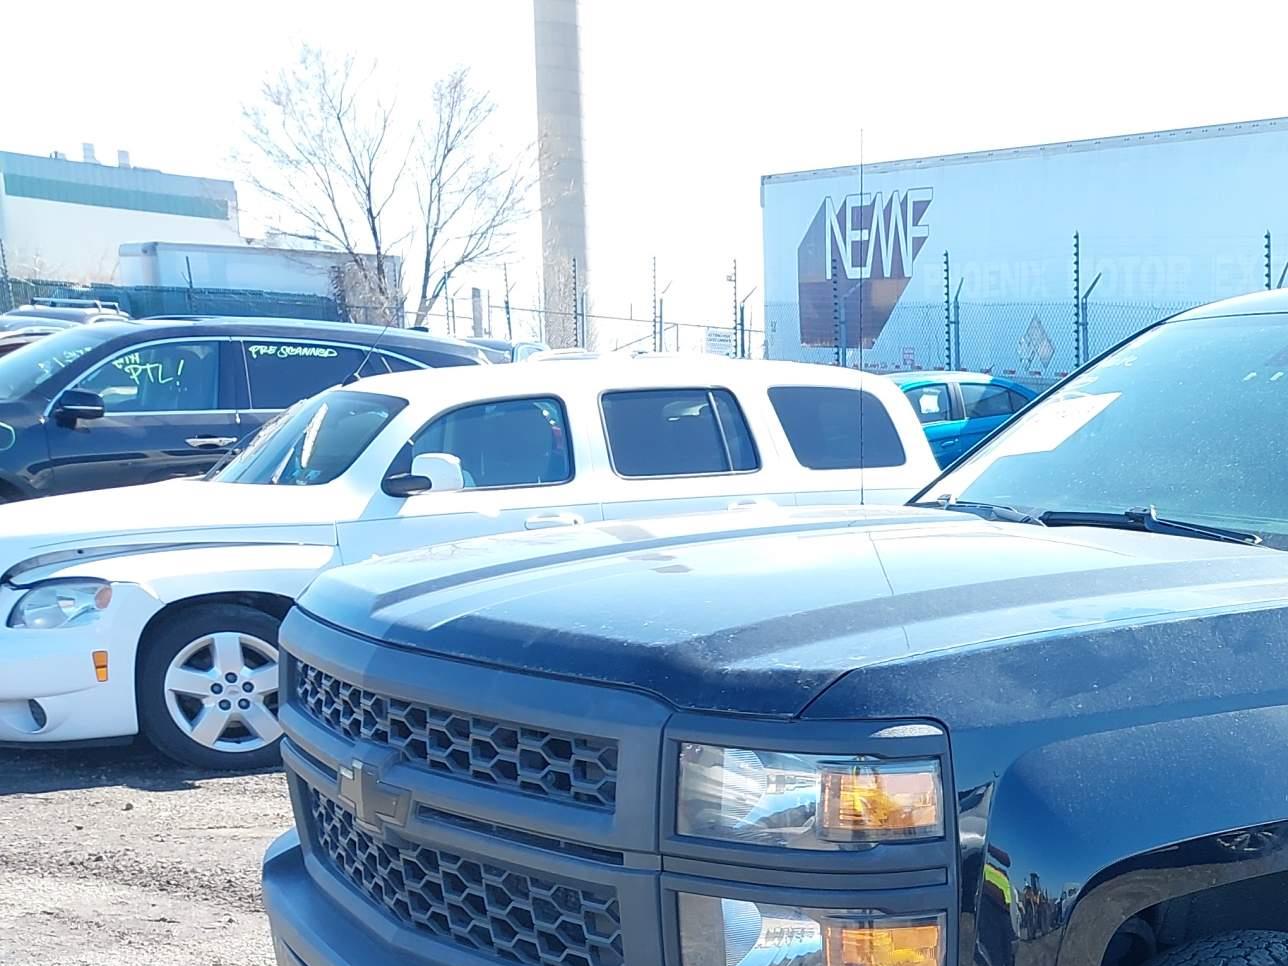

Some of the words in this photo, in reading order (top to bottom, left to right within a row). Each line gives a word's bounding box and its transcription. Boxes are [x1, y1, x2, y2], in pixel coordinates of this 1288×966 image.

[825, 186, 934, 280] NEMF
[248, 344, 278, 359] PRE
[277, 345, 338, 358] SCANNED
